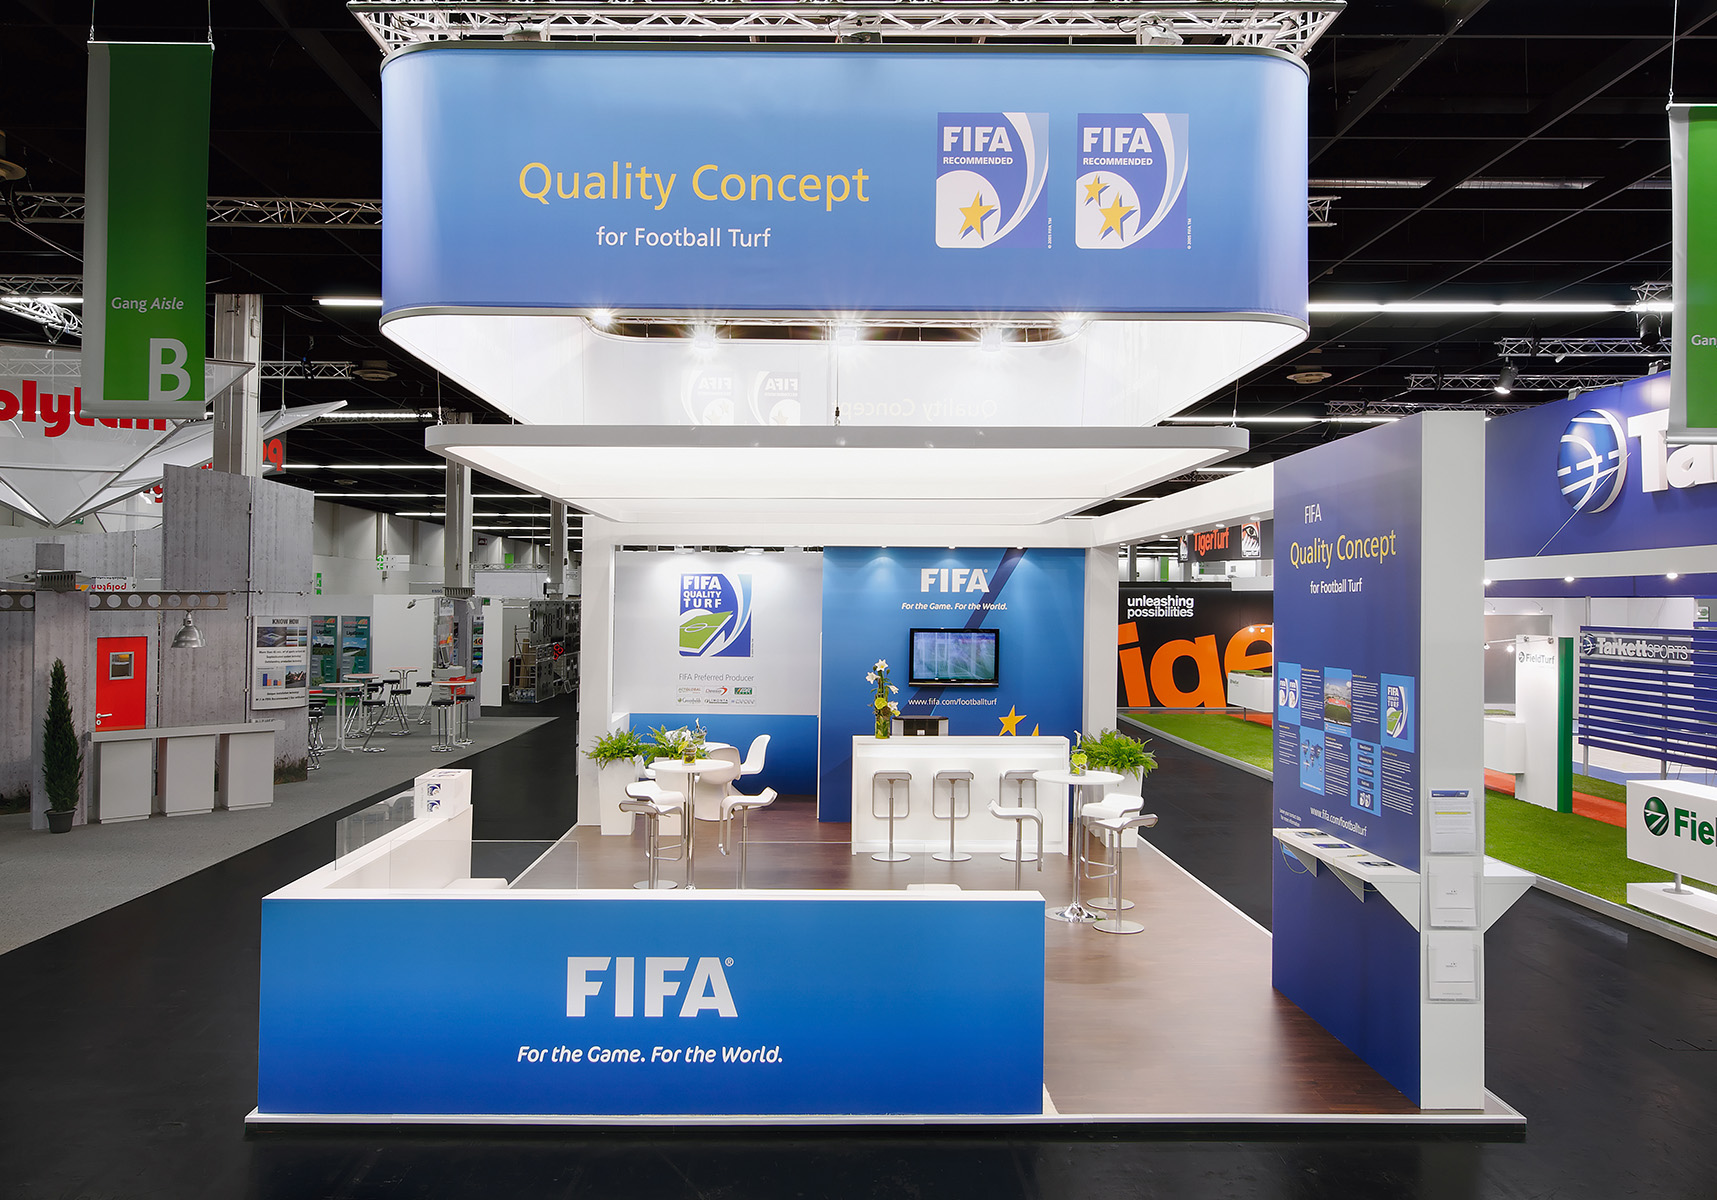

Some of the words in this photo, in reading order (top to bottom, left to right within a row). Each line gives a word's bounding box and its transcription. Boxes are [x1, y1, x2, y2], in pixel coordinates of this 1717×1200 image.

[943, 126, 1013, 152] FIFA
[1083, 127, 1153, 153] FIFA
[943, 157, 1014, 165] RECOMMENDED
[1083, 157, 1153, 166] RECOMMENDED
[519, 161, 677, 211] Quality
[692, 163, 870, 212] Concept
[596, 226, 628, 247] for
[634, 226, 721, 248] Football
[727, 228, 772, 248] Turf
[111, 296, 147, 313] Gang
[150, 297, 184, 311] Aisle
[1691, 334, 1717, 348] Gan
[149, 338, 191, 401] B
[1627, 408, 1717, 494] Ta
[1304, 503, 1322, 524] FIFA
[1193, 527, 1230, 557] TigerTurf
[1290, 537, 1334, 569] Quality
[1337, 529, 1397, 564] Concept
[683, 575, 722, 590] FIFA
[1310, 580, 1320, 594] for
[1320, 578, 1347, 593] Football
[1347, 577, 1363, 593] Turf
[683, 599, 722, 608] TURF
[901, 602, 914, 610] For
[915, 602, 928, 610] the
[929, 602, 953, 610] Game.
[954, 602, 967, 610] For
[968, 602, 981, 610] the
[982, 602, 1008, 610] World.
[1127, 595, 1194, 608] unleashing
[1127, 606, 1194, 619] possibilities
[1525, 653, 1555, 665] FieldTurf
[694, 673, 723, 681] Preferred
[726, 674, 754, 682] Producer
[908, 698, 997, 707] www.fifa.com/footballturf
[1310, 806, 1368, 837] www.fifa.com/footballturf
[1673, 807, 1717, 848] Fie
[517, 1045, 548, 1063] For
[551, 1045, 583, 1063] the
[587, 1045, 646, 1063] Game.
[650, 1045, 682, 1063] For
[685, 1045, 716, 1063] the
[721, 1045, 783, 1063] World.
